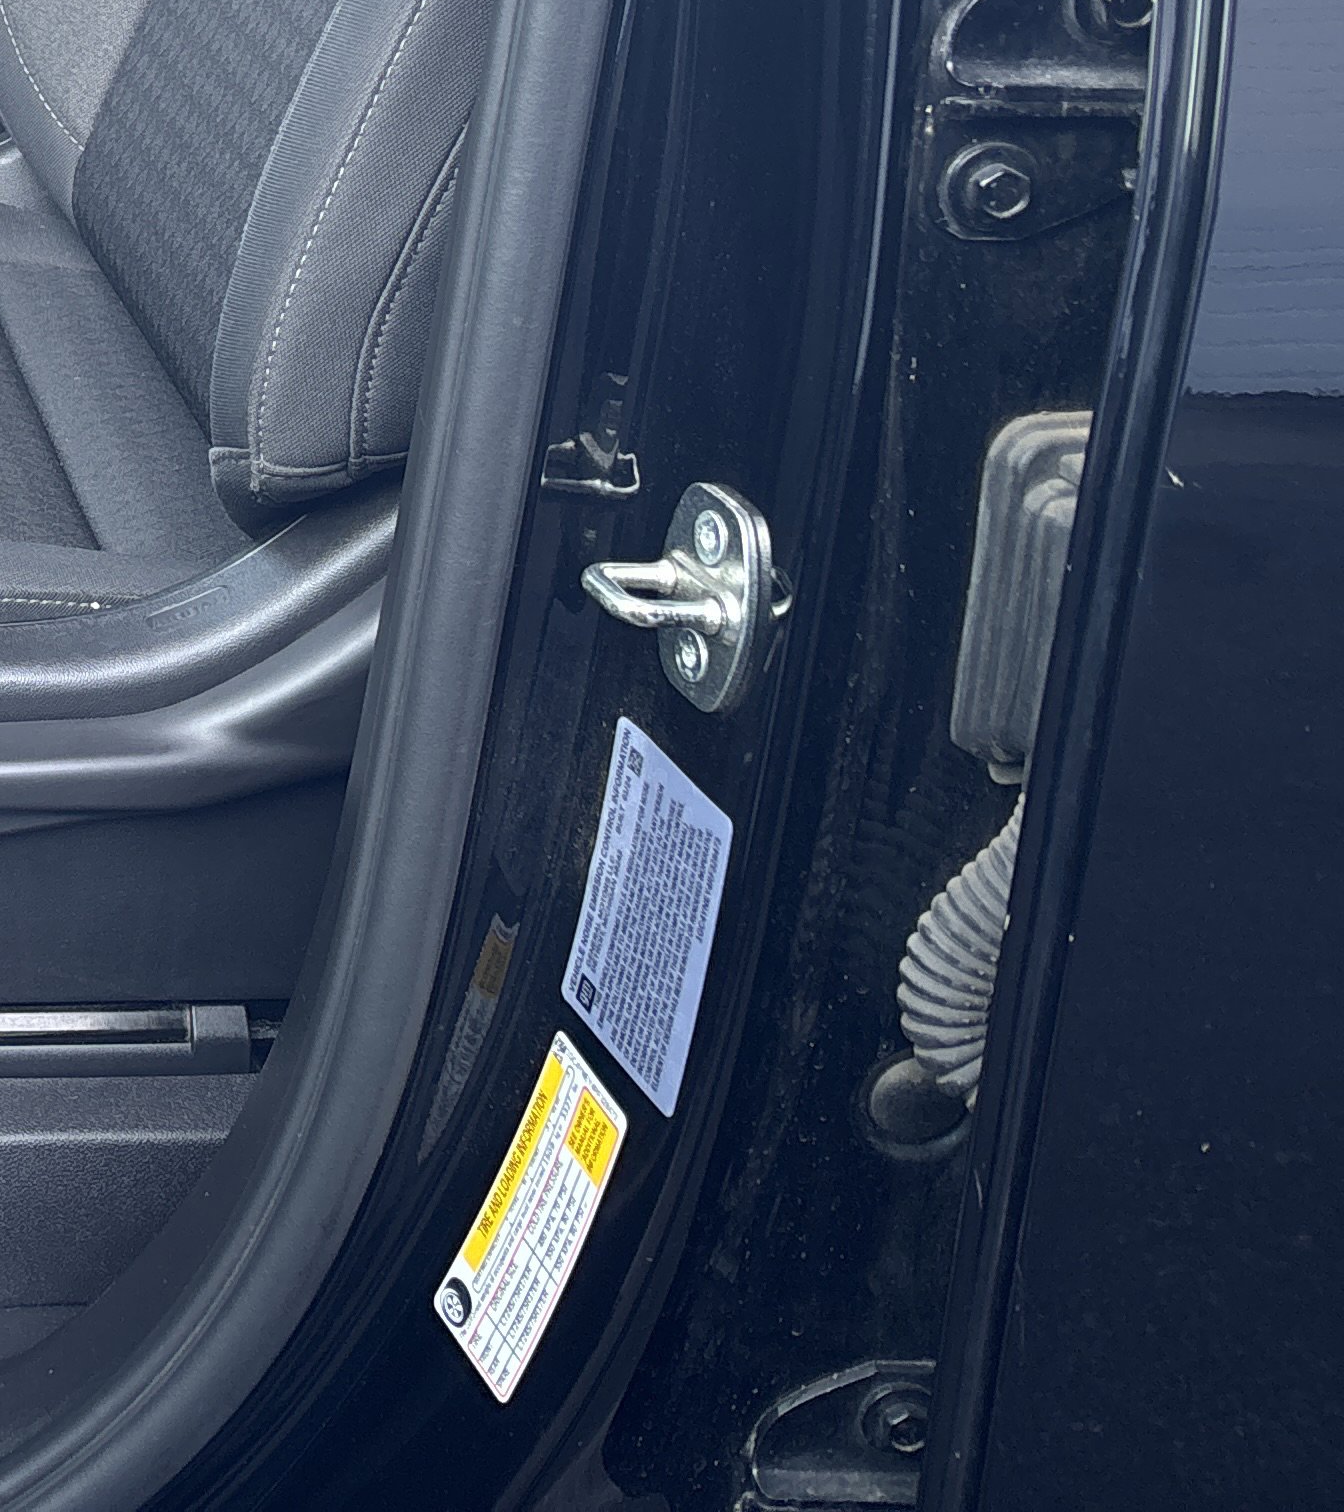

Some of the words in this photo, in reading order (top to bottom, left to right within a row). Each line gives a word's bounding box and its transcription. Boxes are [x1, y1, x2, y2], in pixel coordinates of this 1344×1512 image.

[569, 944, 586, 996] VEHICLE
[580, 909, 594, 948] NOISE
[588, 856, 605, 912] EMISSION
[600, 802, 617, 860] CONTROL
[611, 726, 631, 806] INFORMATION
[477, 1210, 494, 1240] TIRE
[487, 1190, 504, 1219] AND
[497, 1149, 522, 1199] LOADING
[516, 1088, 549, 1158] INFORMATION
